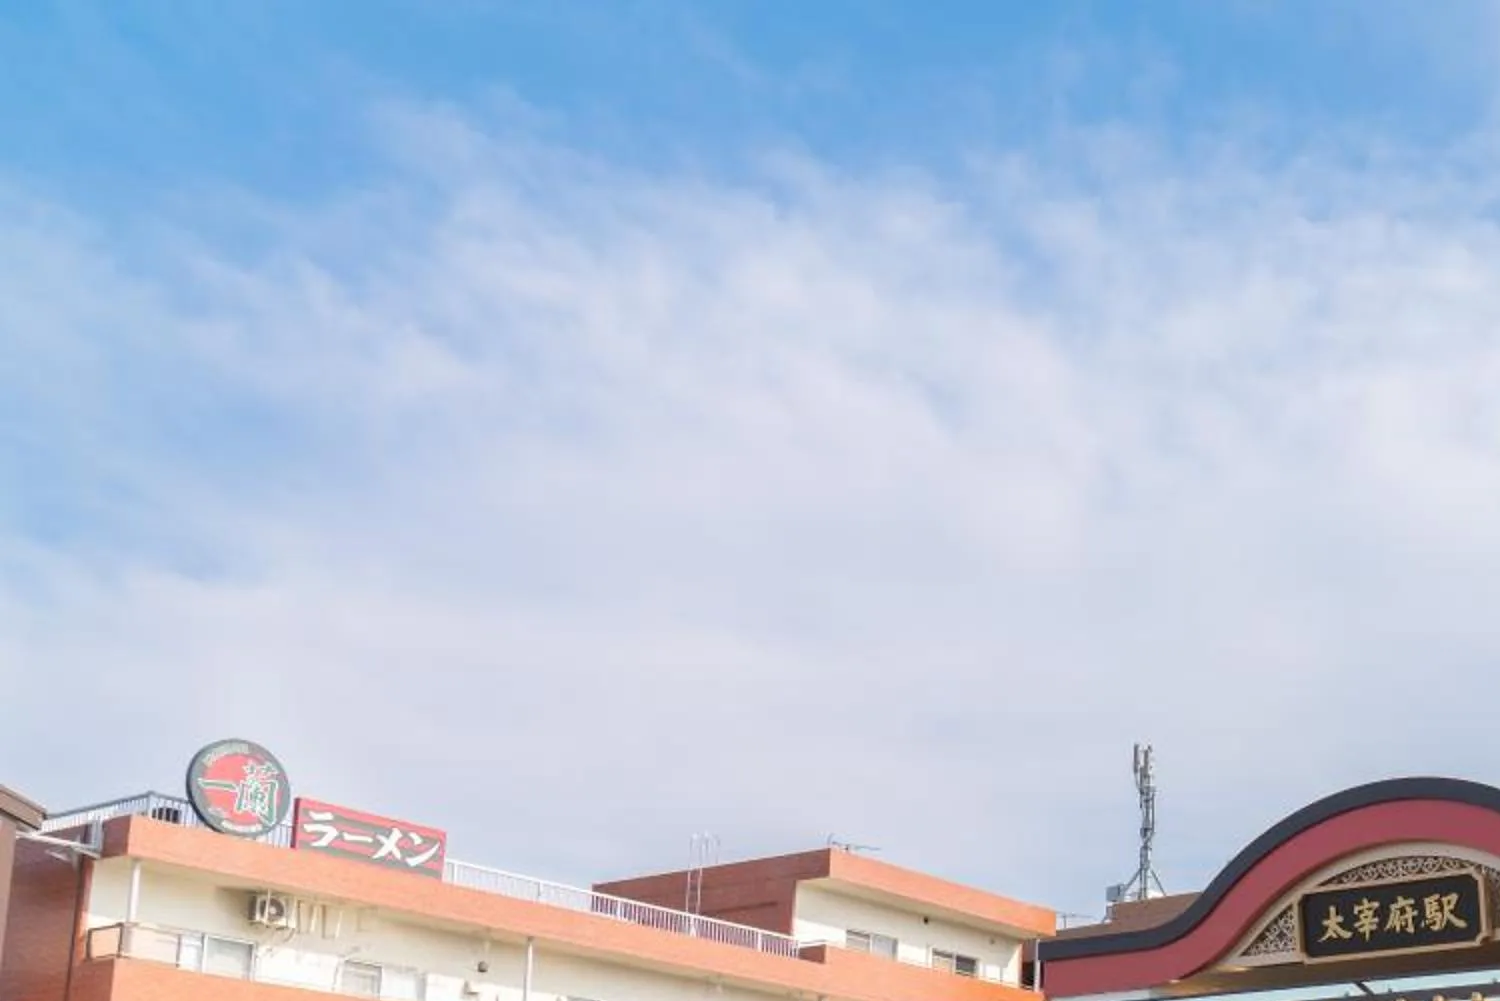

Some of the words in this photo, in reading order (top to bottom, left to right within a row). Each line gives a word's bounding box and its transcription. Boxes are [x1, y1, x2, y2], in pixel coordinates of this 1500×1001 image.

[303, 810, 441, 867] ラーメン
[1317, 892, 1468, 944] 太宰府駅
